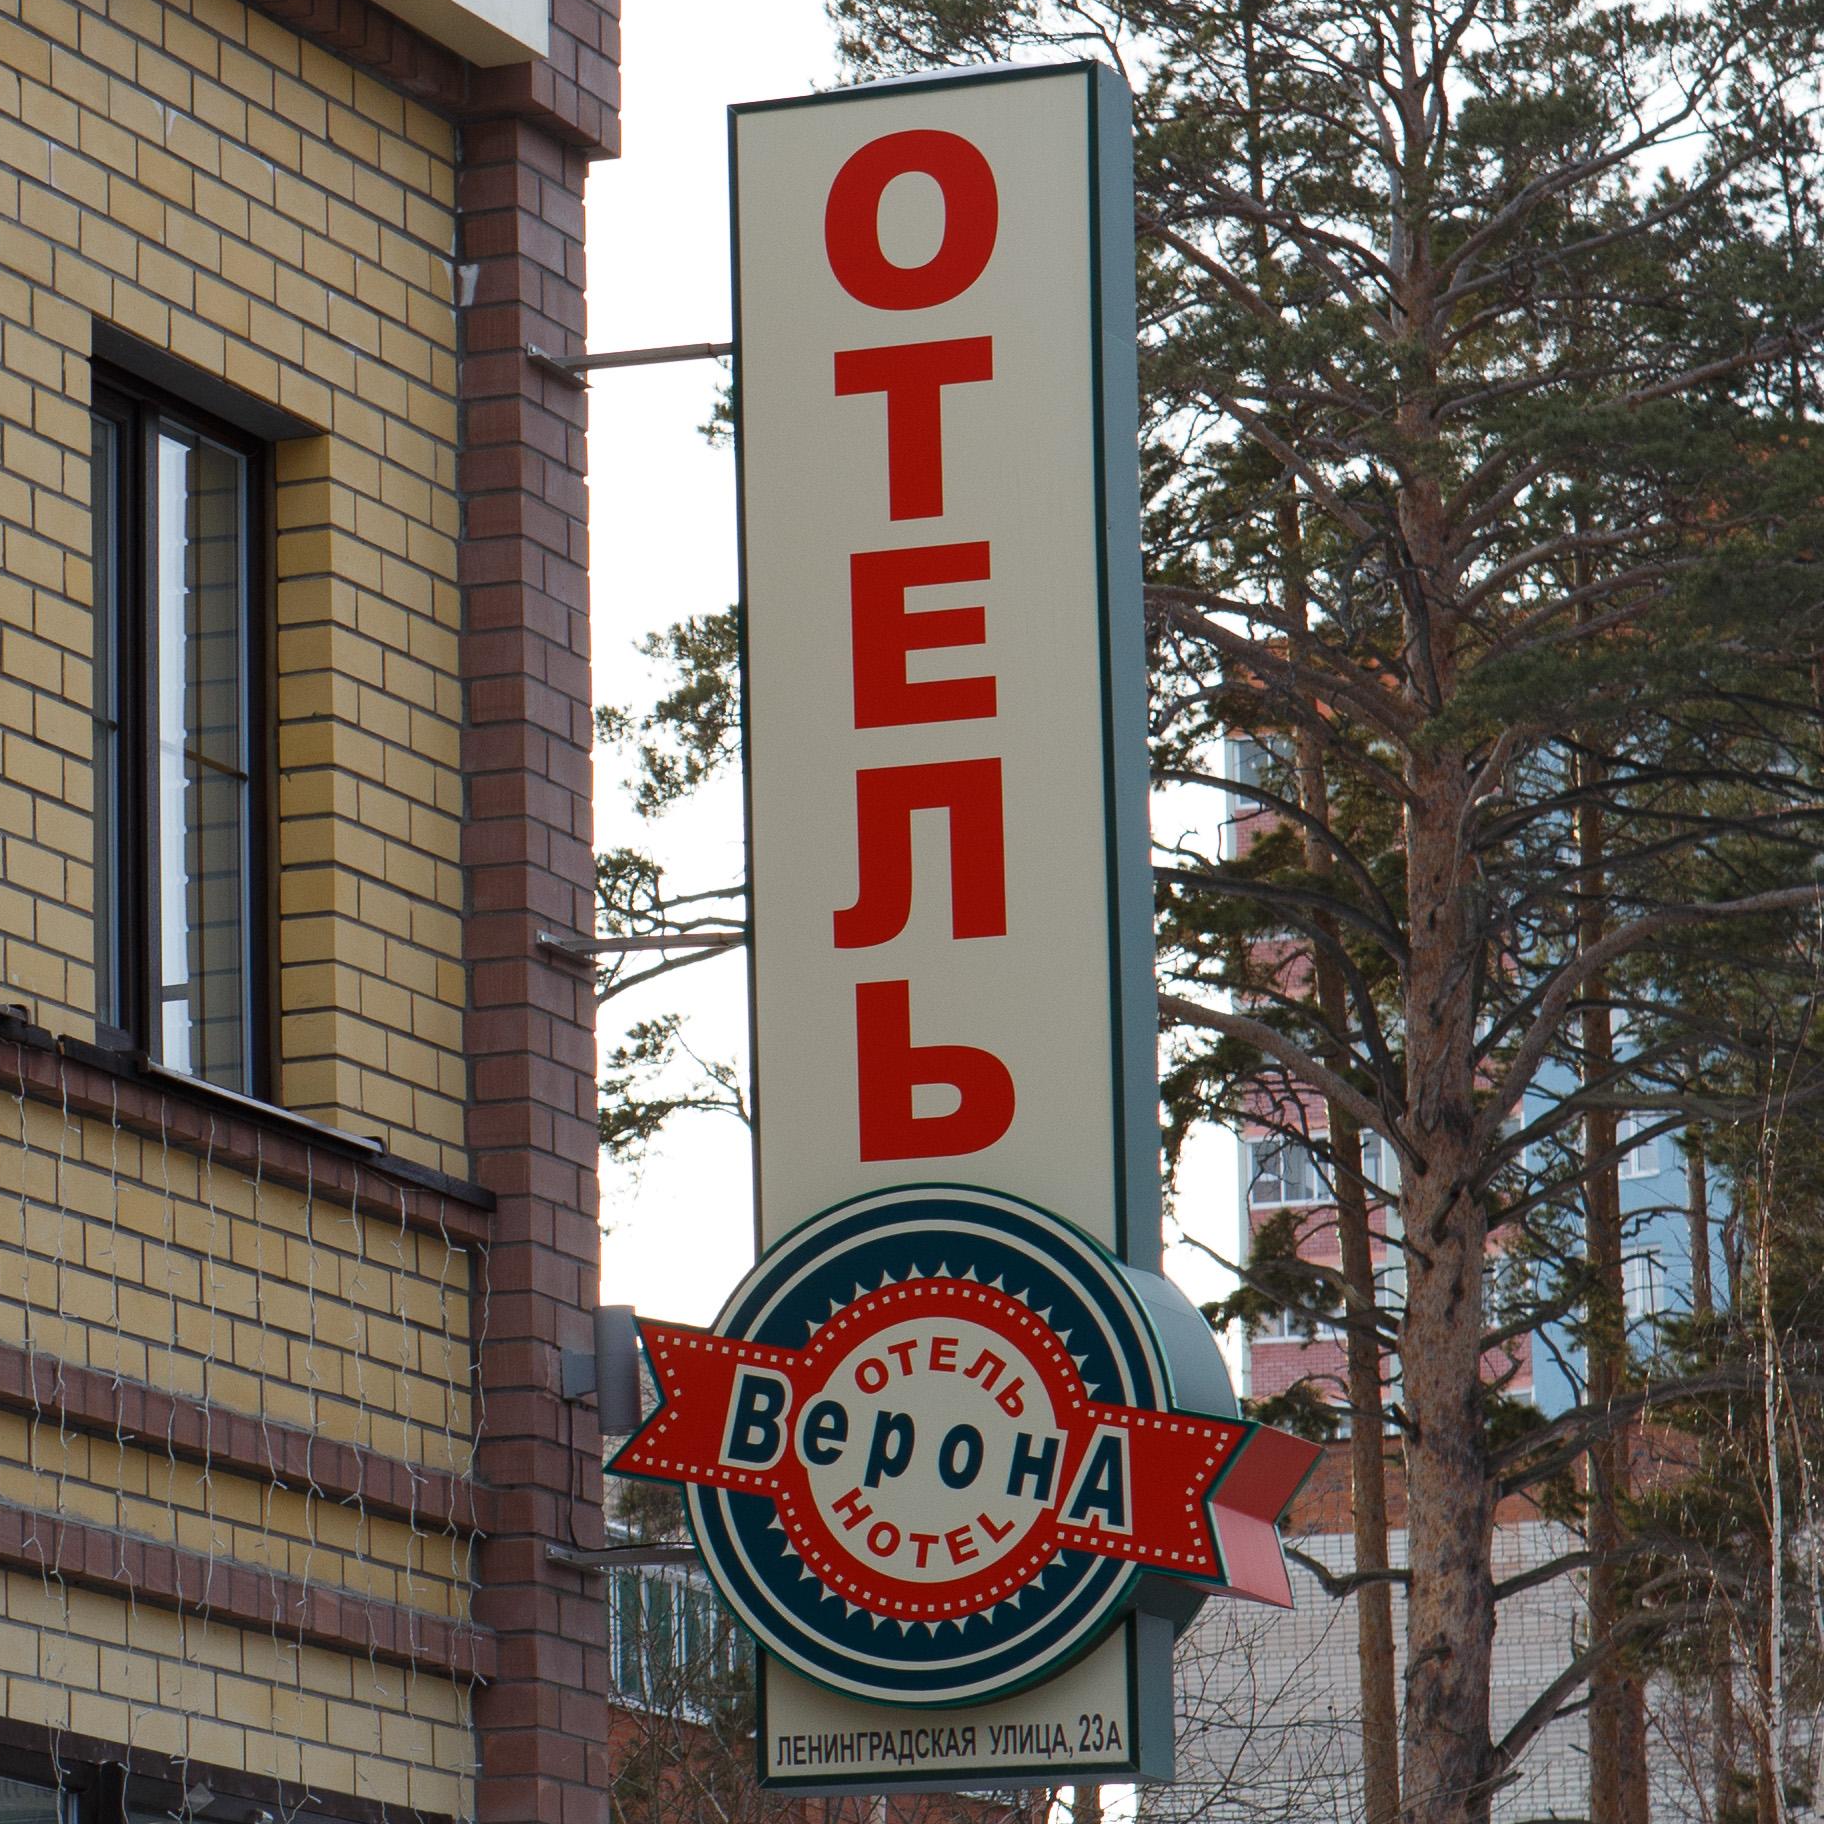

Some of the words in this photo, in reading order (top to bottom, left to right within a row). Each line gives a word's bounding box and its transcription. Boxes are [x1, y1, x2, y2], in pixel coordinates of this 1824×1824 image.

[823, 128, 1017, 1163] ОТЕЛЬ
[854, 1336, 1025, 1418] ОТЕЛЬ
[831, 1487, 1016, 1569] HOTEL
[777, 1726, 976, 1766] ЛЕНИНГРАДСКАЯ
[988, 1722, 1073, 1759] УЛИЦА,
[1078, 1713, 1123, 1753] 23А
